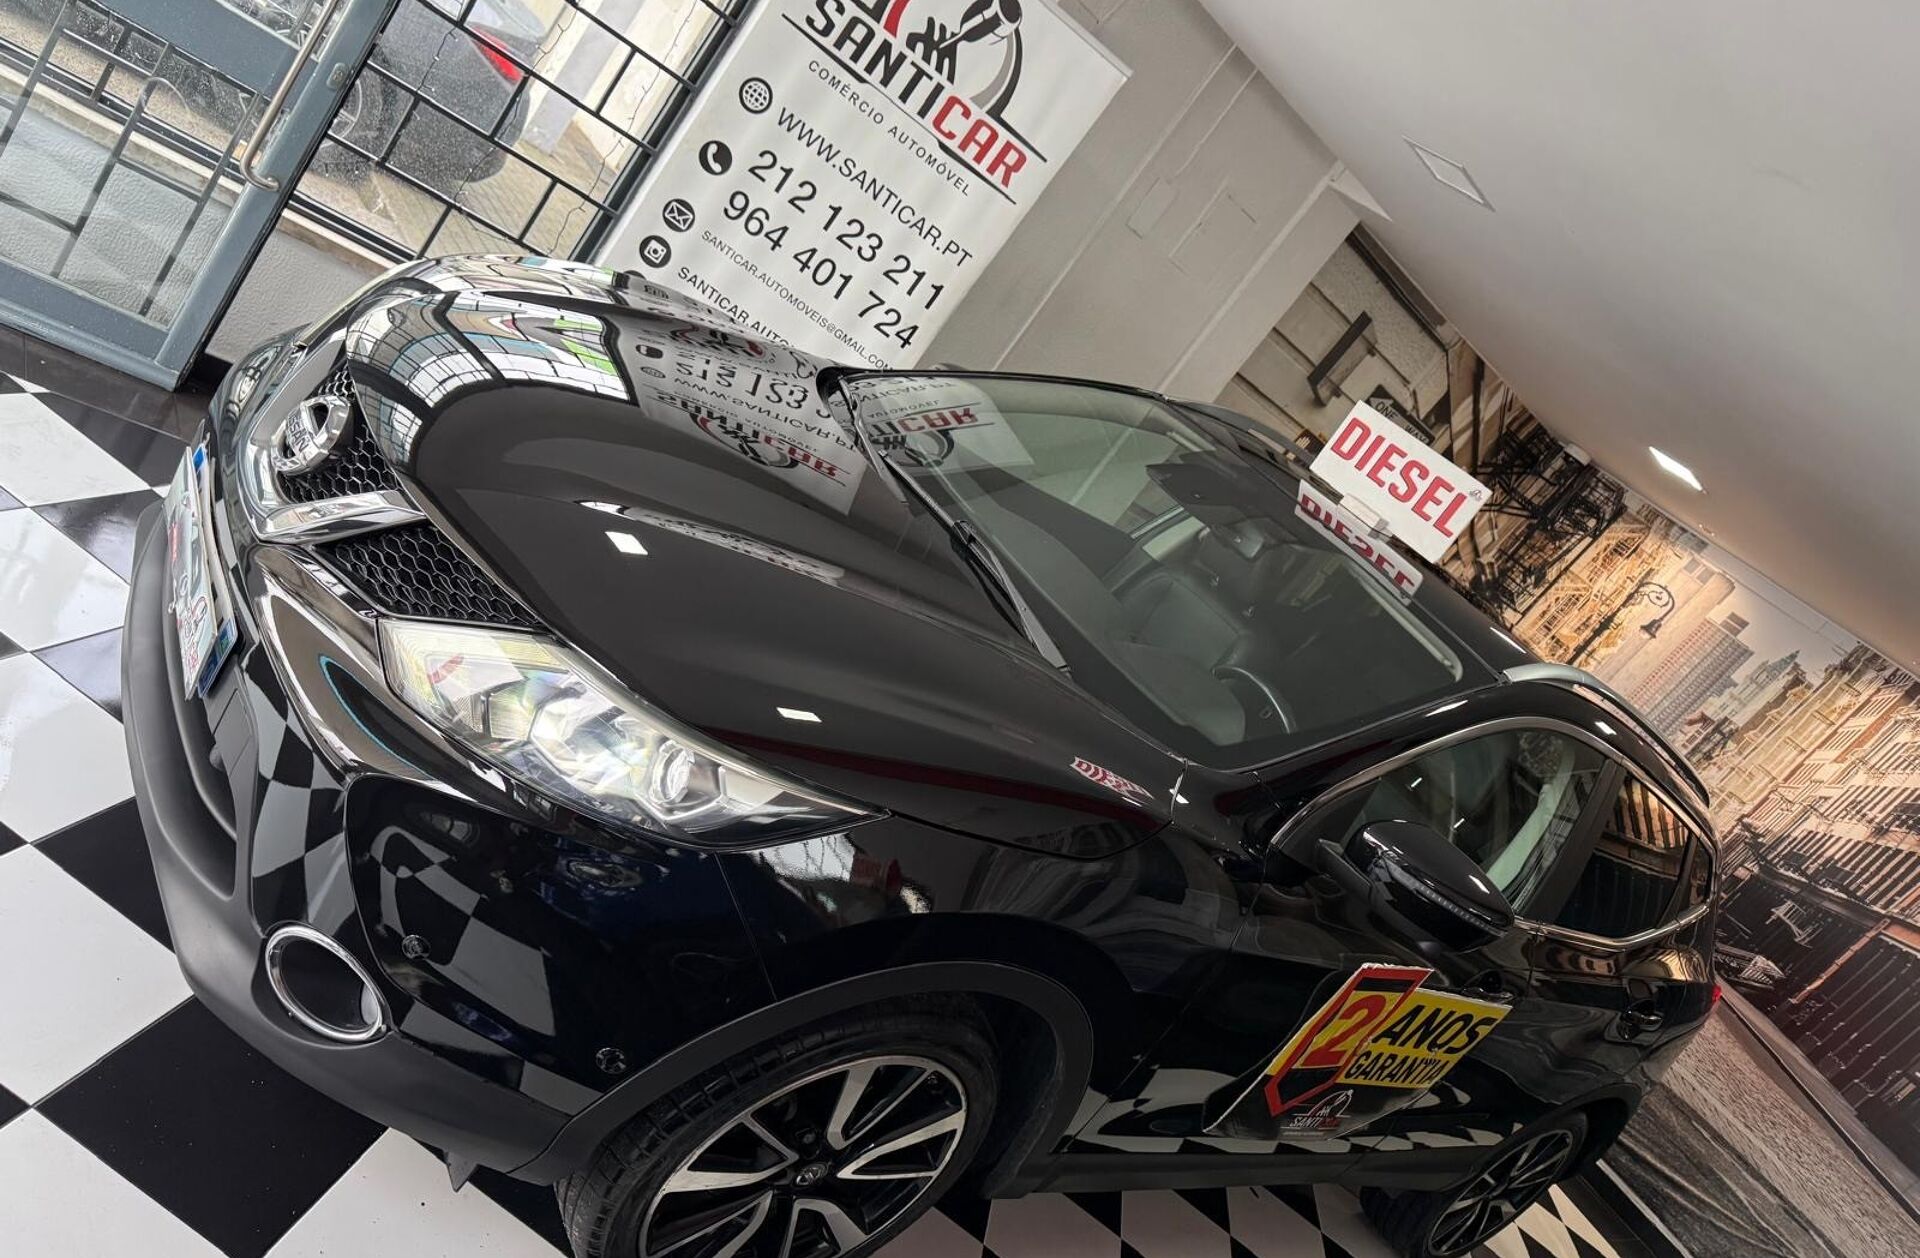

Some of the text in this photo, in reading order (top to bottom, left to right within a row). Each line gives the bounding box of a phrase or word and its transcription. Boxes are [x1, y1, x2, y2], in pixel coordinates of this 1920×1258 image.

[805, 0, 1028, 189] SANTICAR
[808, 60, 969, 197] COMÉRCIO AUTOMÓVEL
[748, 150, 945, 311] 212 123 211
[778, 107, 973, 267] WWW.SANTICAR.PT
[723, 191, 919, 349] 964 401 724
[1331, 417, 1467, 538] DIESEL
[1300, 993, 1498, 1067] 2 ANOS
[1344, 1051, 1450, 1085] GARANTIA
